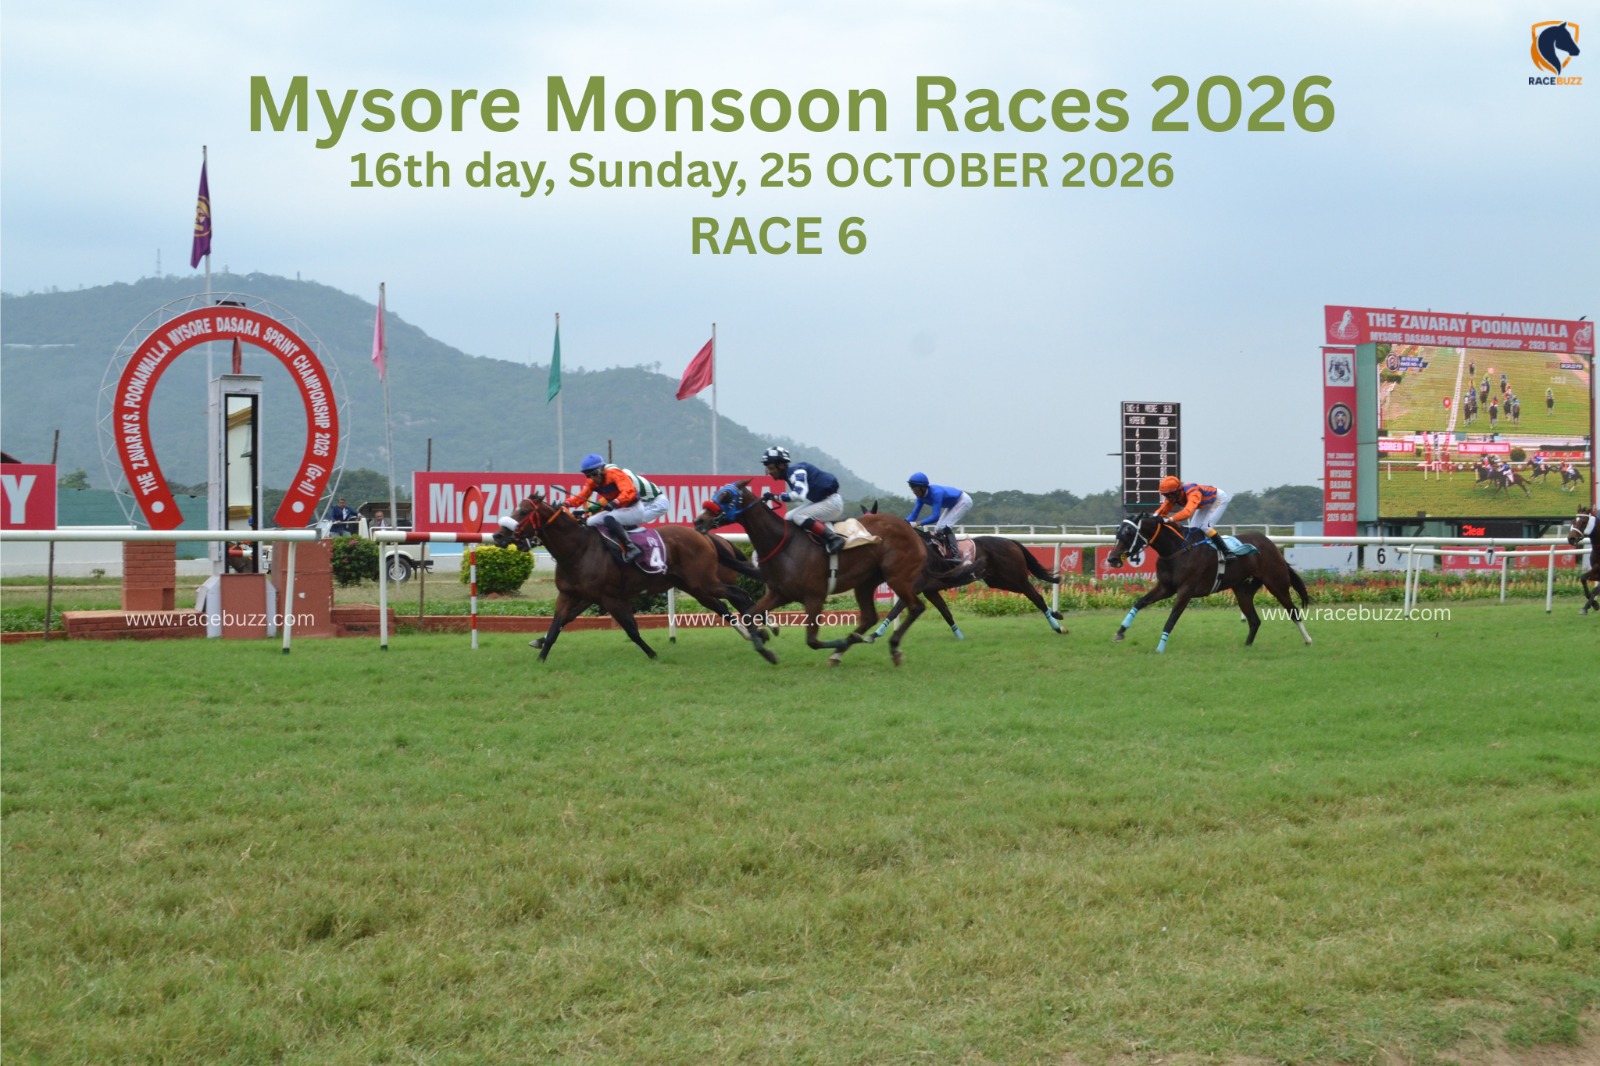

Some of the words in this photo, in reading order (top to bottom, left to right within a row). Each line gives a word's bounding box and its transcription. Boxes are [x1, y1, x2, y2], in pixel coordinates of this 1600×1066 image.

[166, 317, 213, 346] MYSORE
[216, 317, 260, 338] DASARA
[1366, 312, 1397, 328] THE
[1400, 314, 1468, 333] ZAVARAY
[1471, 319, 1569, 338] POONAWALLA
[262, 326, 300, 358] SPRINT
[123, 339, 172, 408] POONAWALLA
[292, 354, 331, 429] CHAMPIONSHIP
[123, 411, 140, 423] S.
[123, 423, 149, 470] ZAVARAY
[313, 432, 331, 457] 2026
[136, 471, 159, 496] THE
[1462, 525, 1486, 536] Clear
[1129, 550, 1141, 566] 4
[1377, 547, 1386, 564] 6
[1487, 549, 1494, 565] 7
